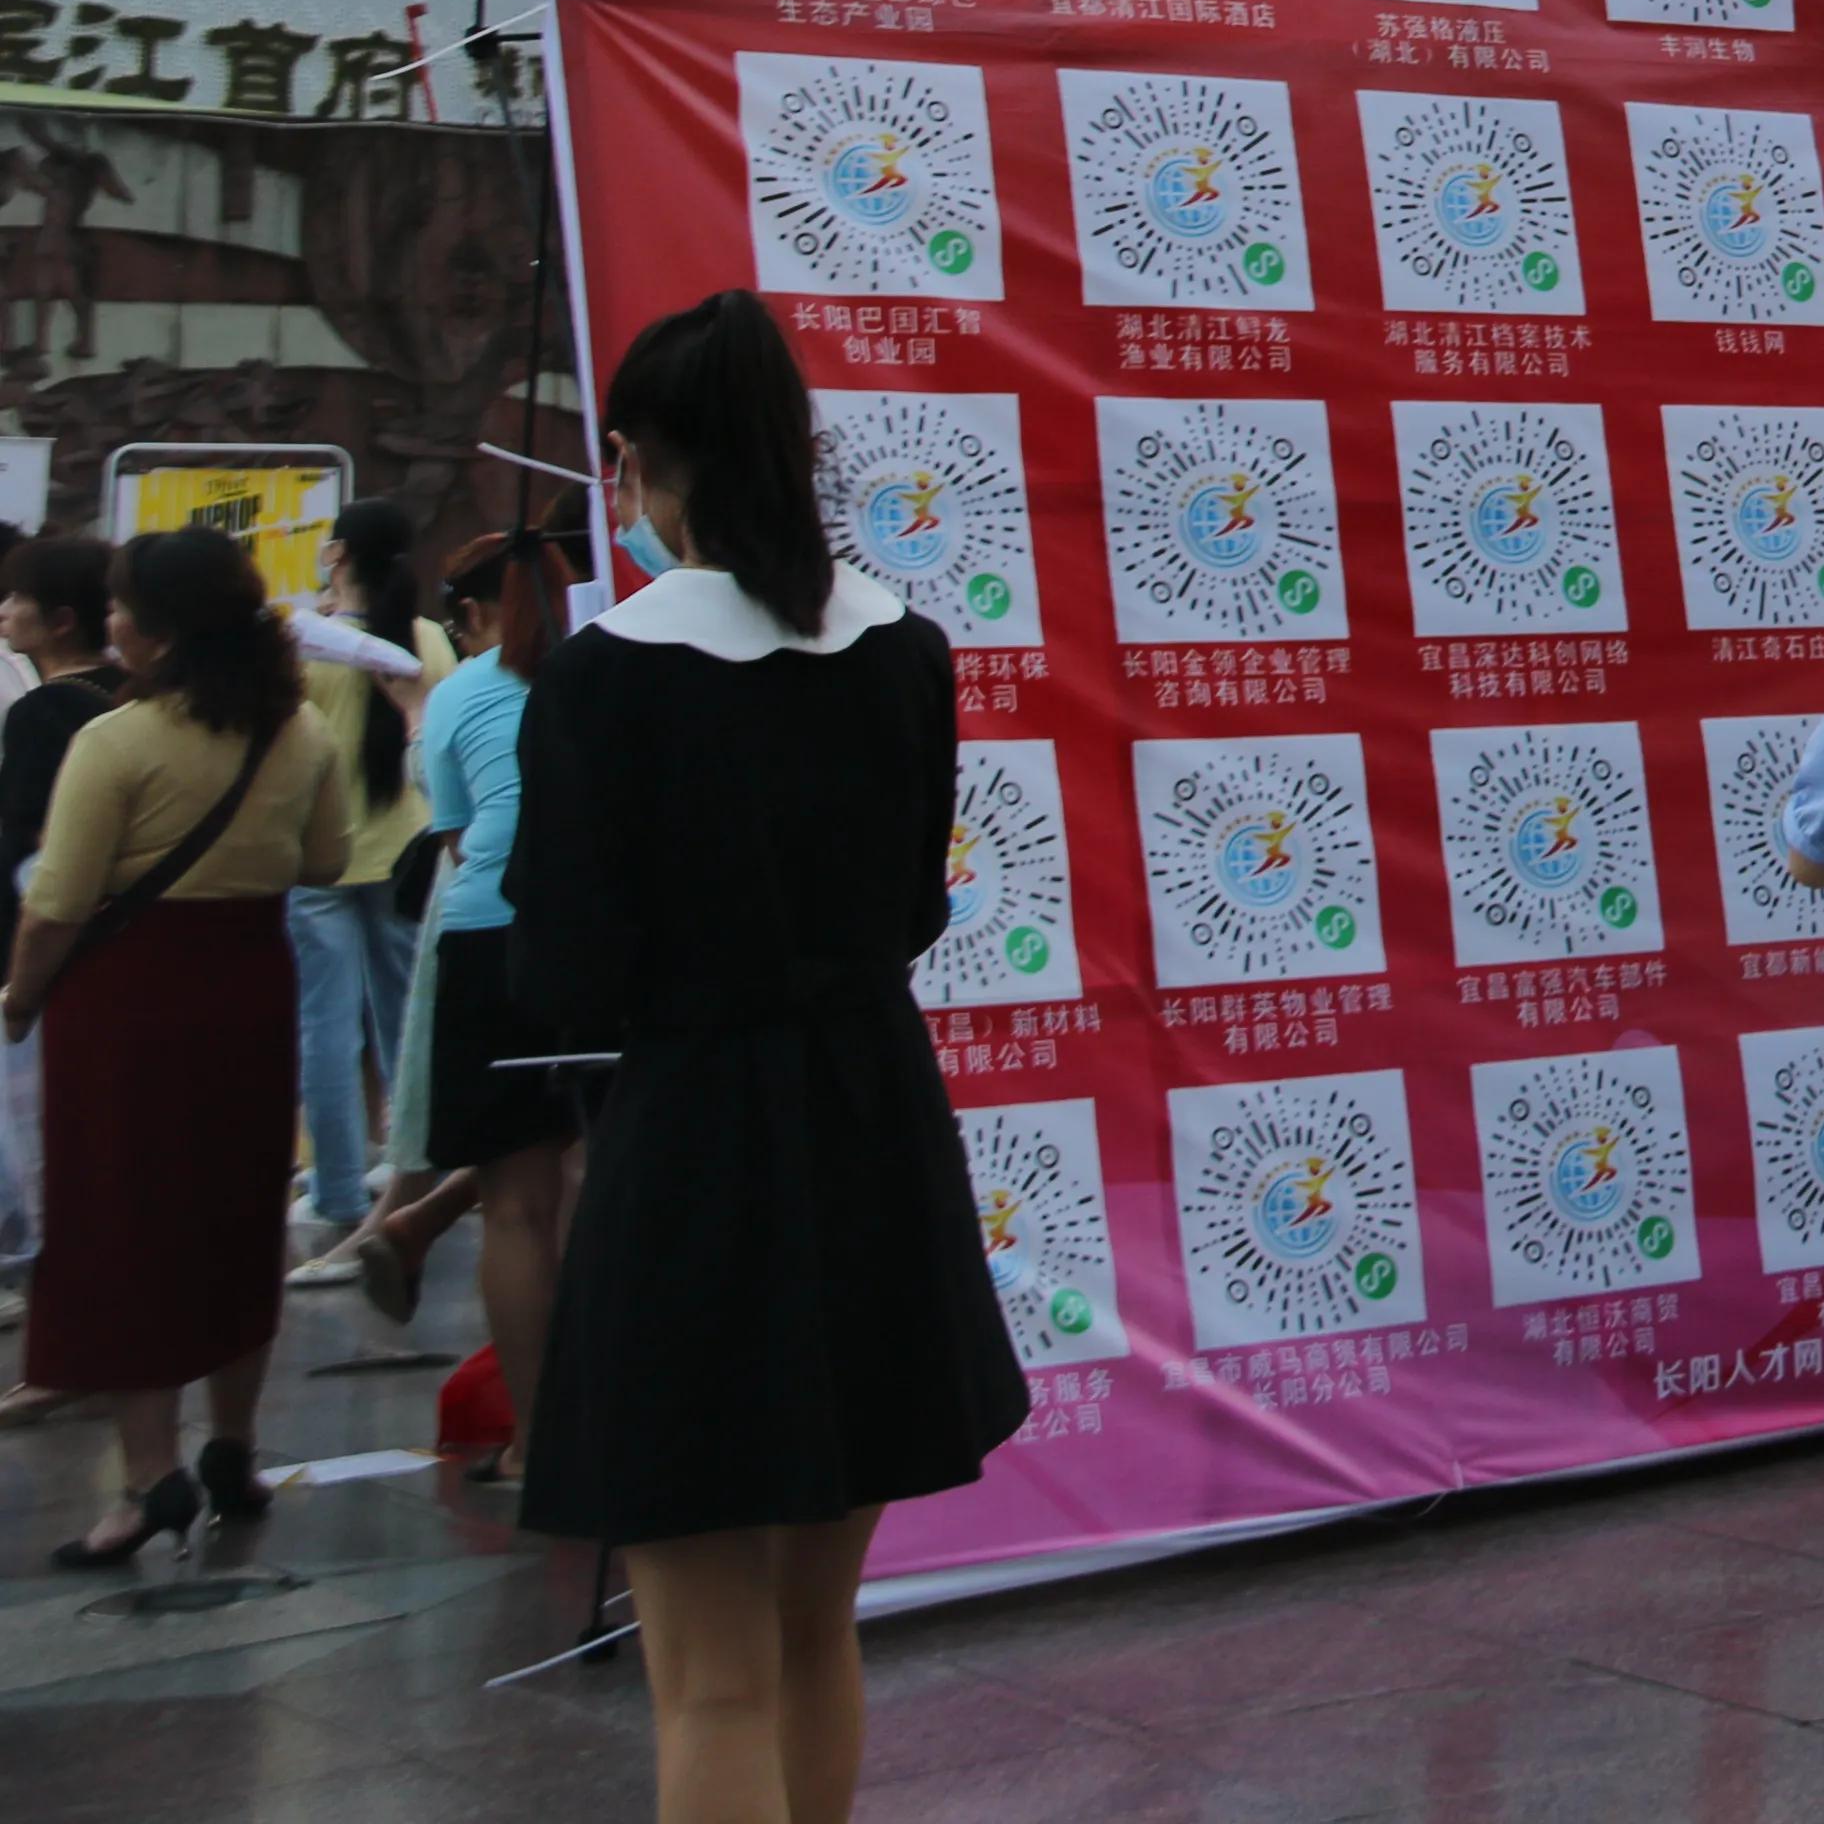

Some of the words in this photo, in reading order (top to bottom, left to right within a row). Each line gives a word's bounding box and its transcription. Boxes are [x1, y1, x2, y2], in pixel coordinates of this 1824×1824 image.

[1374, 12, 1507, 45] 苏强格液压
[1658, 33, 1756, 63] 丰润生物
[790, 301, 982, 335] 长阳巴国汇智
[1383, 319, 1593, 350] 湖北清江档案技术
[842, 335, 936, 366] 创业园
[1118, 342, 1292, 373] 渔业有限公司
[1413, 349, 1571, 378] 服务有限公司
[1121, 646, 1353, 679] 长阳金领企业管理
[958, 684, 1019, 714] 公司
[1154, 676, 1328, 709] 咨询有限公司
[1448, 667, 1607, 700] 科技有限公司
[1159, 982, 1395, 1029] 长阳群英物业管理
[1516, 993, 1621, 1029] 有限公司
[1223, 1017, 1339, 1055] 有限公司
[936, 1038, 1058, 1078] 有限公司
[1553, 1326, 1656, 1367] 有限公司
[1653, 1337, 1824, 1401] 长阳人才网
[1252, 1364, 1394, 1410] 长阳分公司
